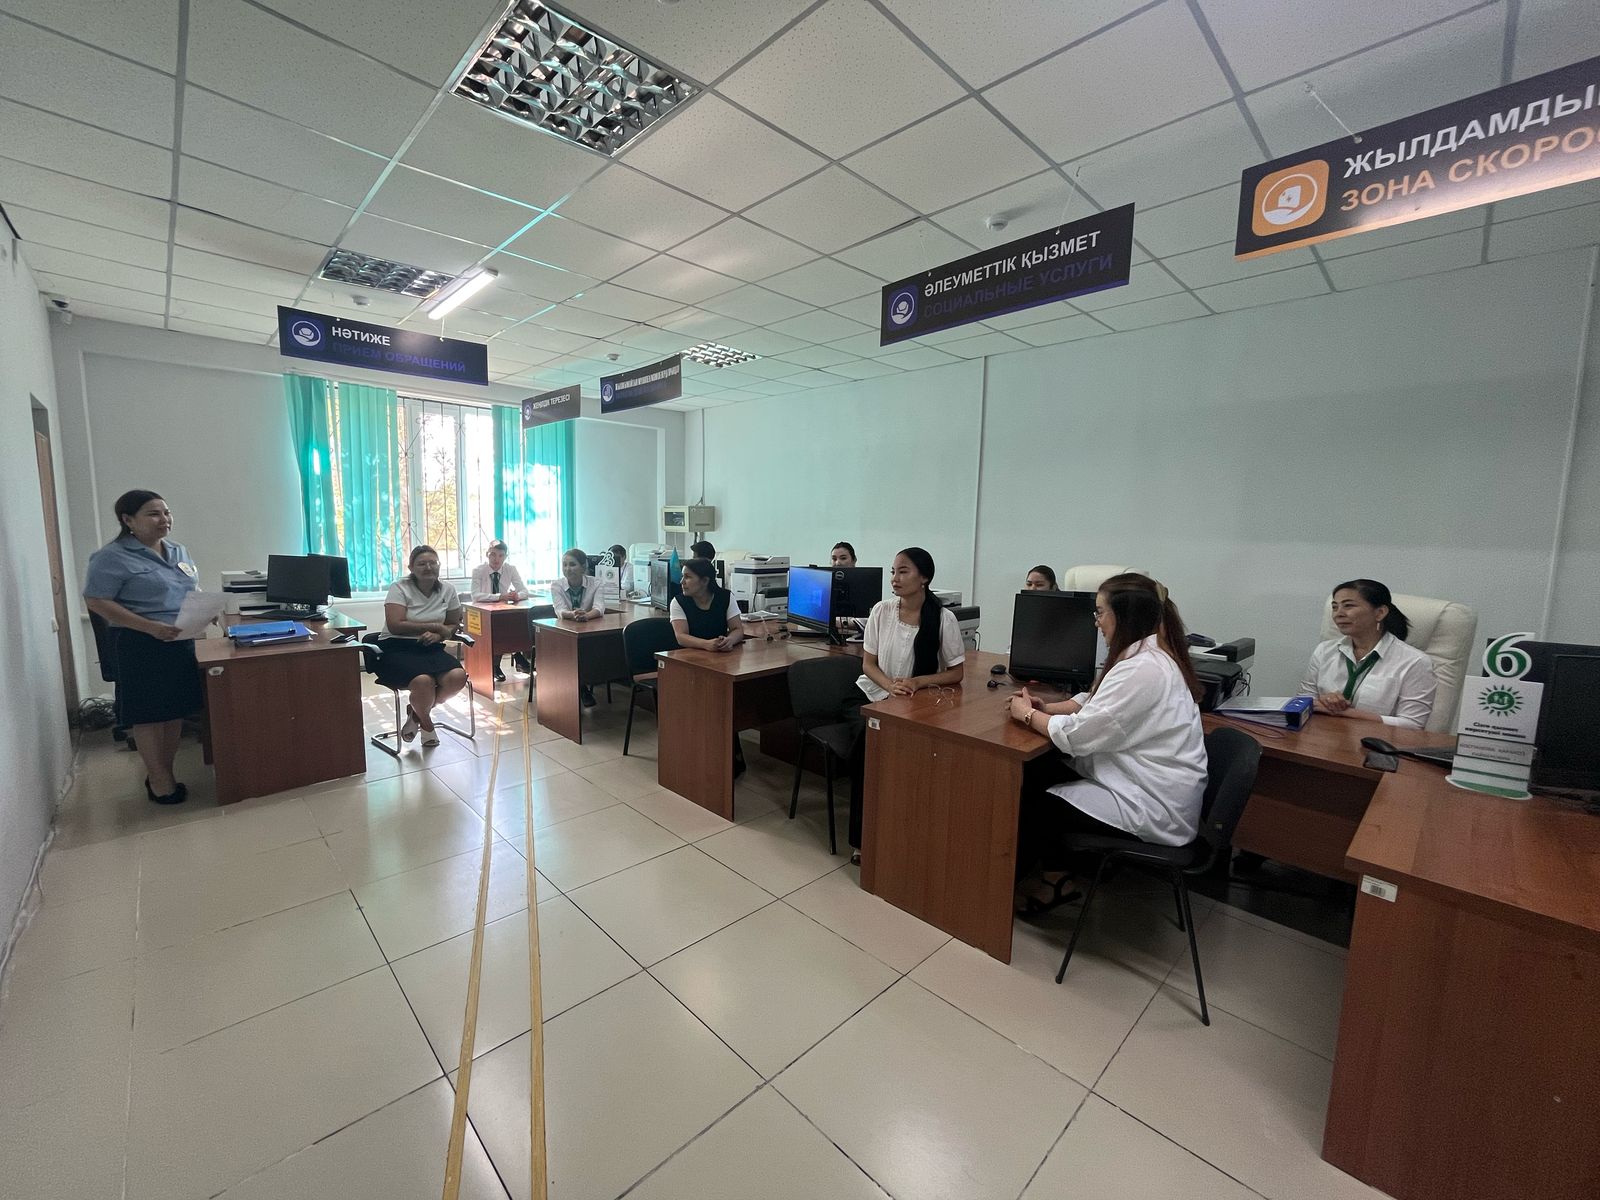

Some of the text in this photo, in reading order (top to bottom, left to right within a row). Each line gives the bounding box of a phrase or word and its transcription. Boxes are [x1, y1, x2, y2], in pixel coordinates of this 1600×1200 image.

[1343, 82, 1600, 178] ЖЫЛДАМДЫ
[1340, 124, 1600, 212] ЗОНА СКОРО
[923, 253, 1113, 319] СОЦИАЛЬНЫЕ УСЛУГИ
[924, 230, 1101, 297] ӘЛЕУМЕТТІК ҚЫЗМЕТ
[331, 326, 391, 346] НӘТИЖЕ
[332, 343, 466, 373] ПРИЕМ ОБРАЩЕНИЙ
[1485, 633, 1530, 678] 6
